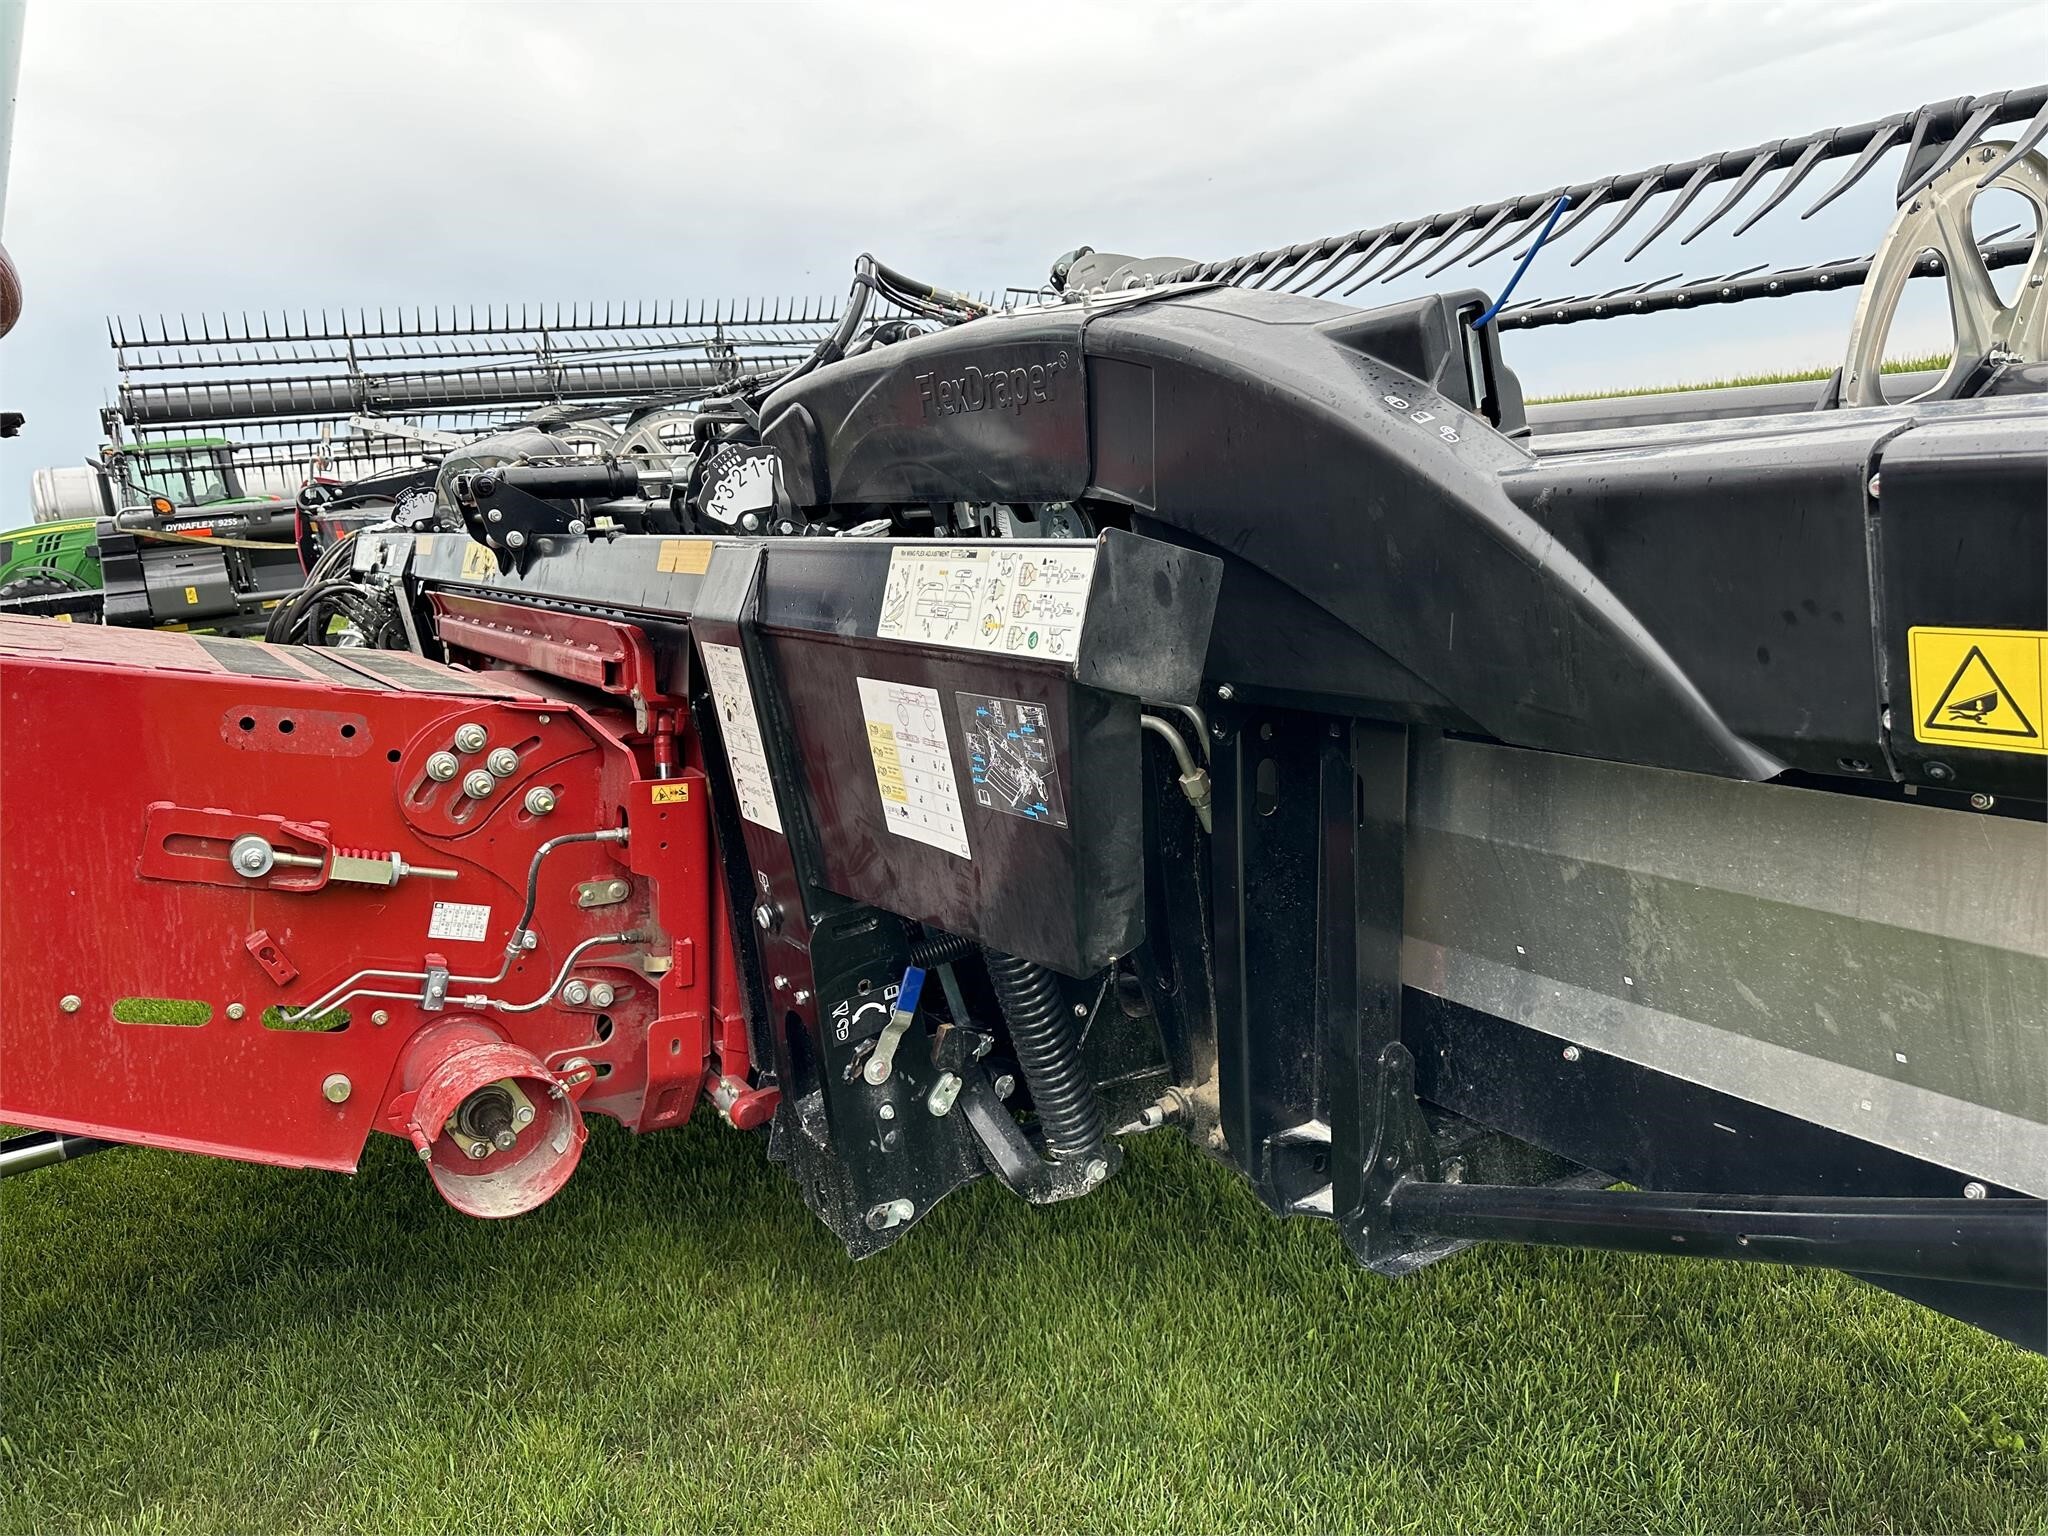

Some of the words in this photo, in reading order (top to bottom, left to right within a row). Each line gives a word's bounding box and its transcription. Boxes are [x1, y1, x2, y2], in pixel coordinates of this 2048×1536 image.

[750, 460, 760, 478] 1
[732, 469, 748, 488] 2
[718, 484, 735, 499] 3
[401, 507, 411, 515] 3
[409, 499, 418, 509] 2
[429, 493, 435, 503] 0
[710, 503, 728, 515] 4
[165, 520, 215, 532] DYNAFLEX
[217, 518, 238, 527] 9255
